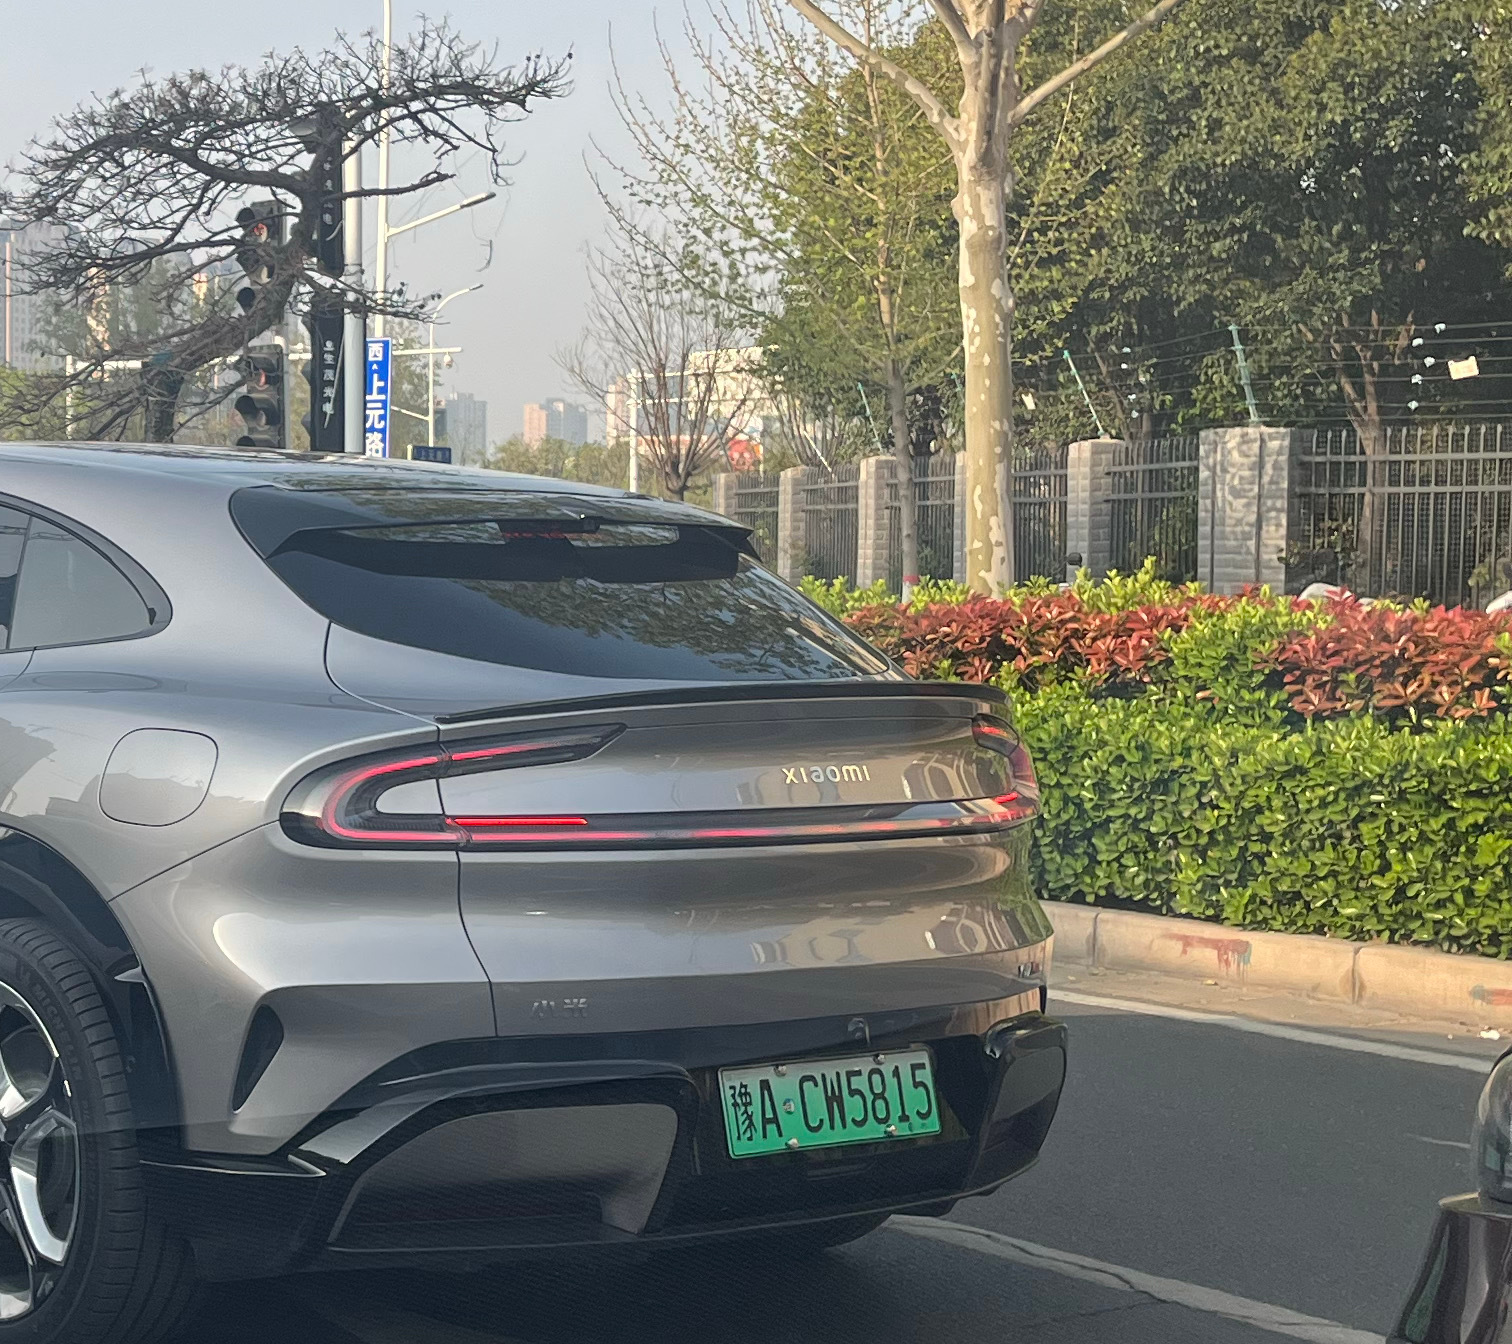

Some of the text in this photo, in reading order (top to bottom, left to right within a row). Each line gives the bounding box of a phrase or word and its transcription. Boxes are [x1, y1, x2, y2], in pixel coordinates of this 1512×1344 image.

[368, 343, 383, 361] 西
[366, 373, 385, 457] 上元路
